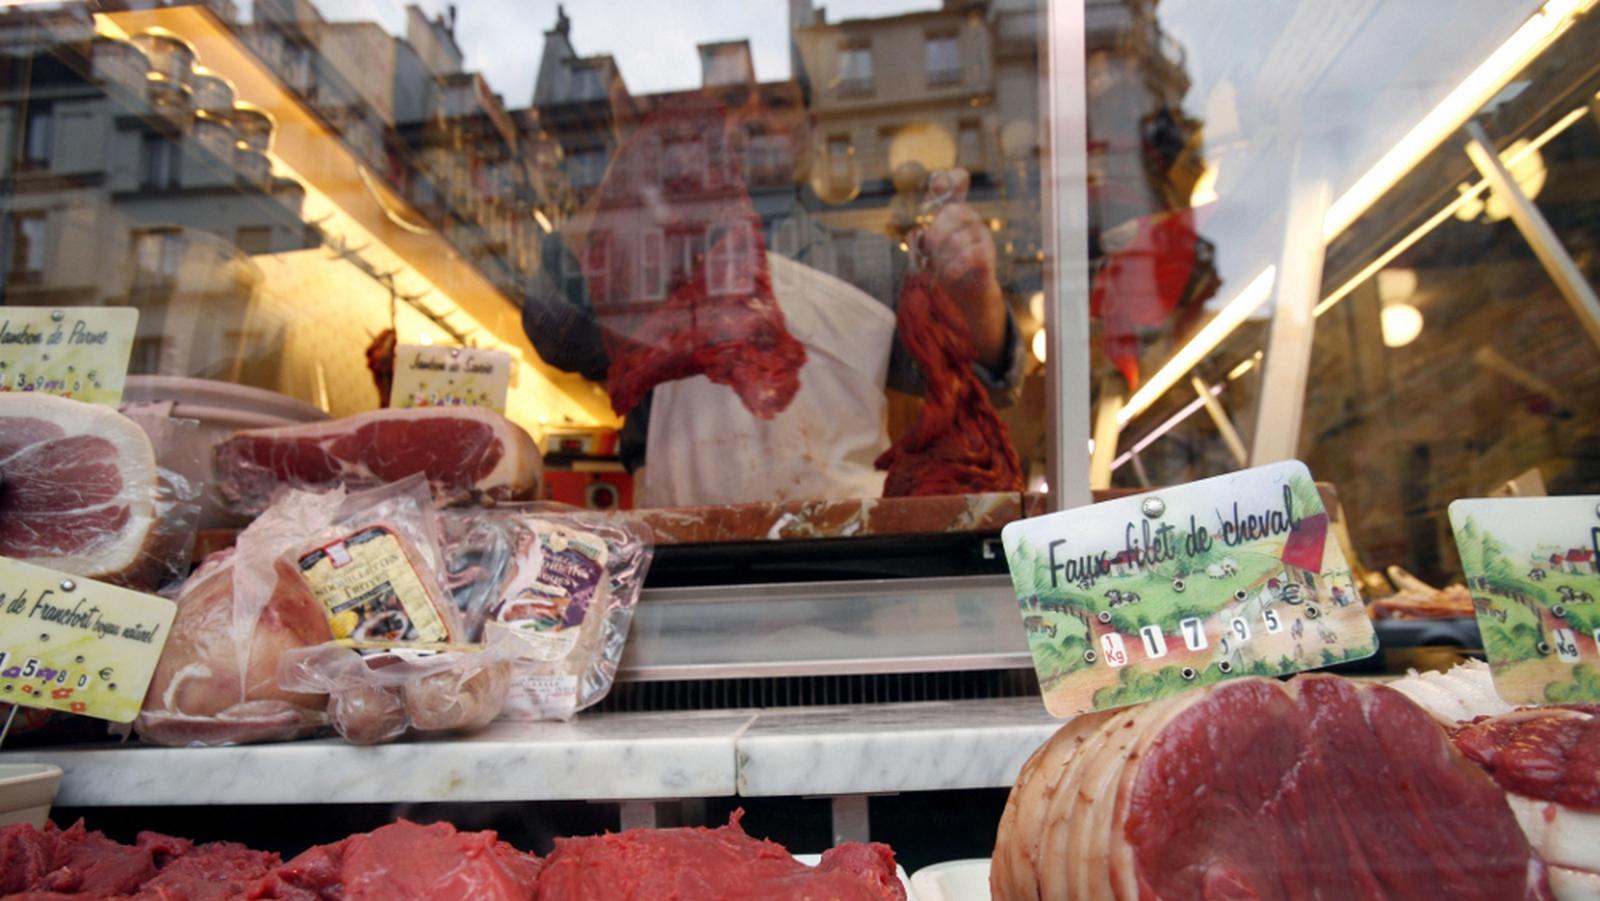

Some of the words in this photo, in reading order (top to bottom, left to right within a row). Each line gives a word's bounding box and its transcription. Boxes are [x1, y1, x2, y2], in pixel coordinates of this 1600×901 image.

[68, 319, 109, 345] Parme
[1048, 517, 1179, 588] Faux-filet
[1185, 514, 1214, 556] de
[1221, 485, 1302, 547] cheval
[6, 588, 28, 615] de
[28, 589, 100, 630] Francfort
[121, 622, 161, 644] naturel
[1104, 650, 1126, 664] Kg
[1556, 642, 1579, 658] Kg
